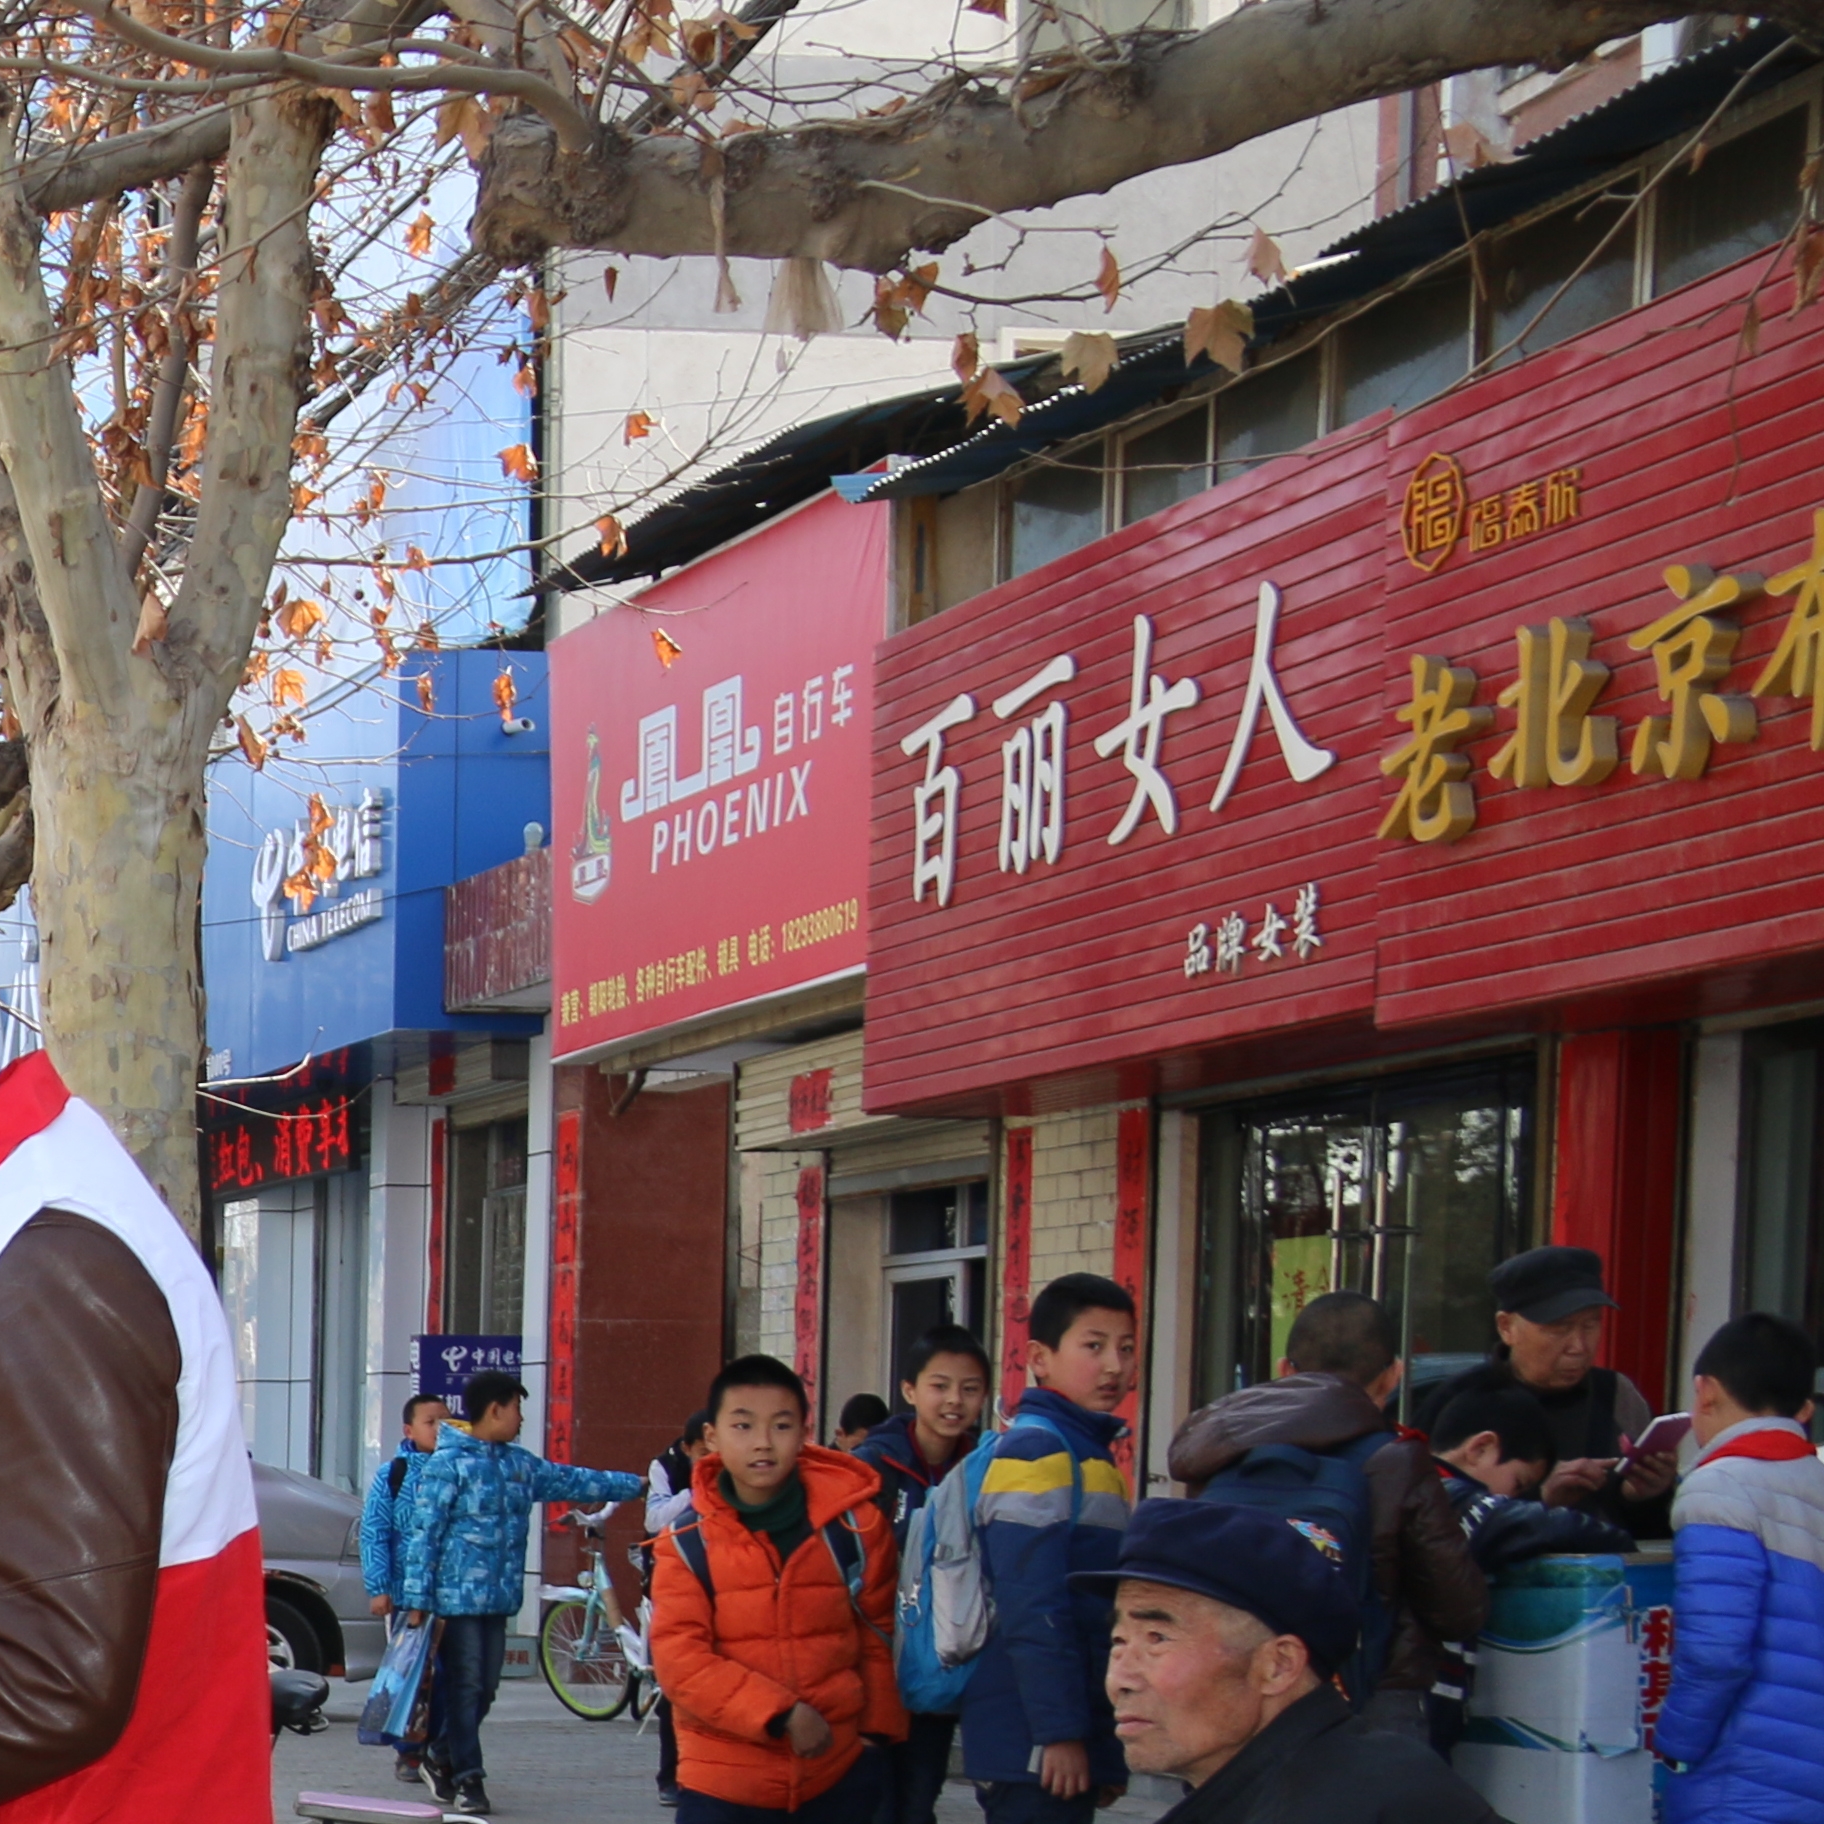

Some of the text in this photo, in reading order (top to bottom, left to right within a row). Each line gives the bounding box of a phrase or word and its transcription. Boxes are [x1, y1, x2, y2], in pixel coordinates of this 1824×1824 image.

[772, 663, 855, 756] 自行车
[900, 579, 1337, 907] 百丽女人
[286, 787, 383, 915] 电信
[651, 759, 813, 874] PHOENIX
[287, 889, 382, 953] CHINA TELECOM
[1183, 881, 1323, 978] 品牌女装
